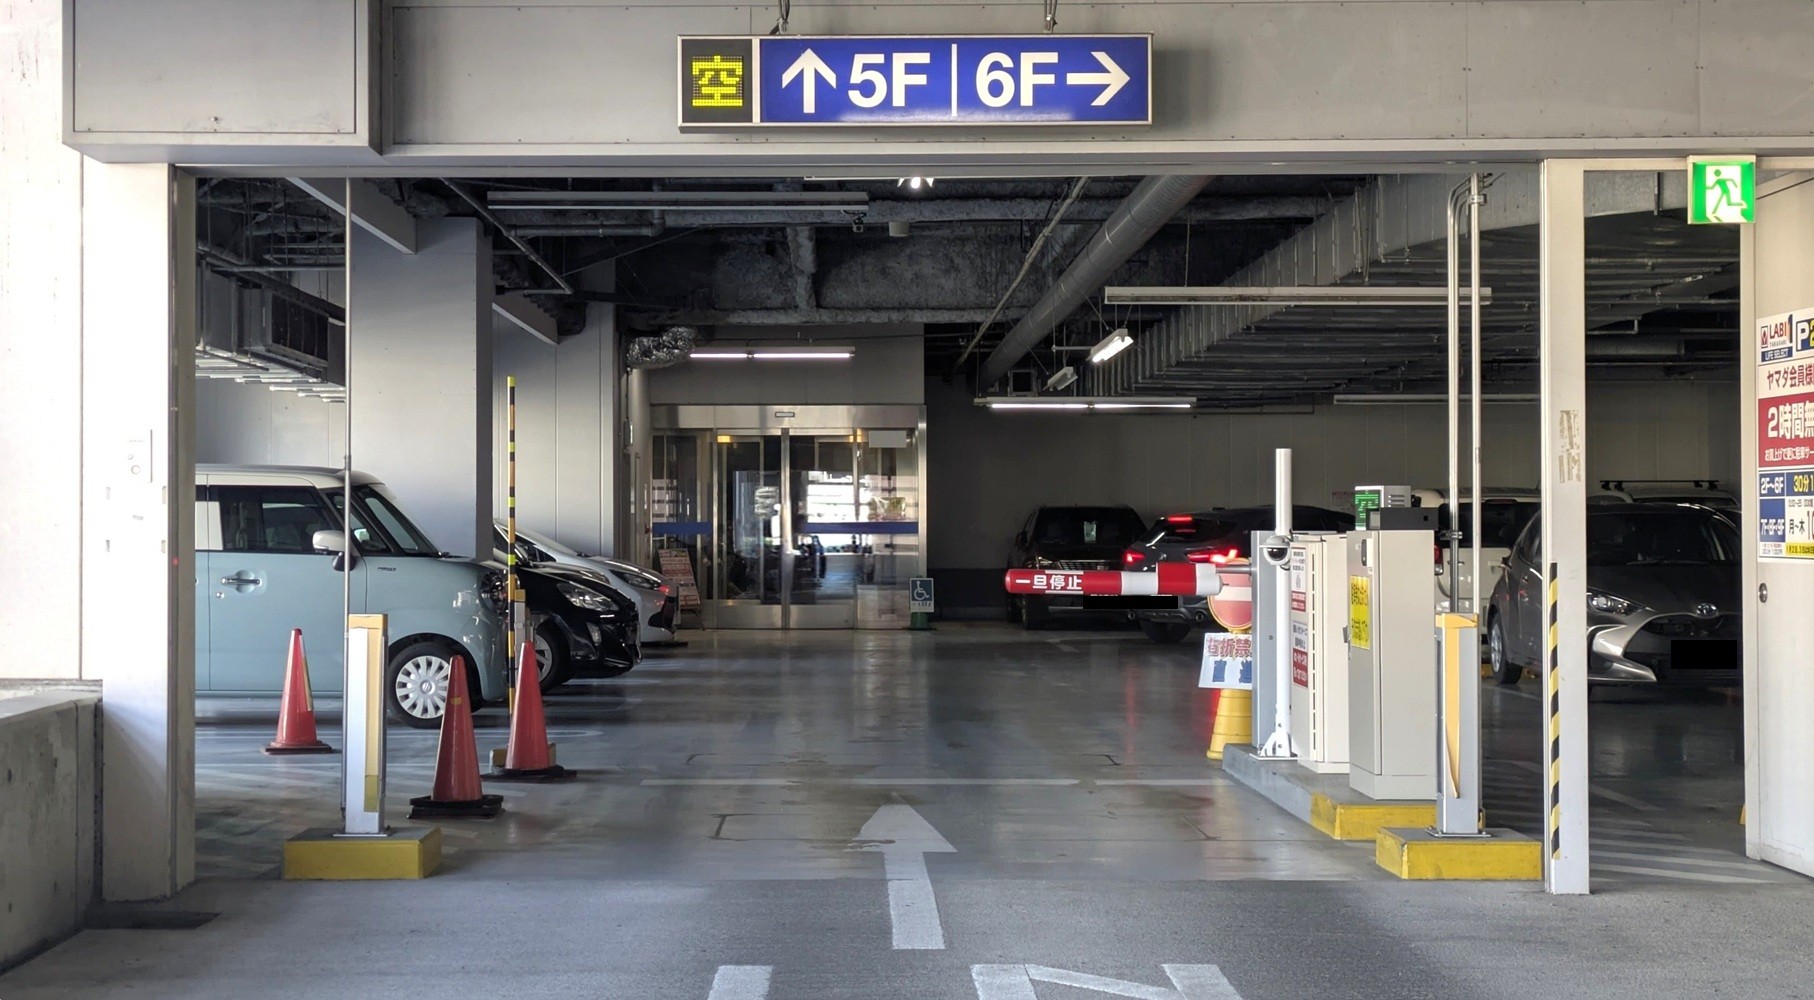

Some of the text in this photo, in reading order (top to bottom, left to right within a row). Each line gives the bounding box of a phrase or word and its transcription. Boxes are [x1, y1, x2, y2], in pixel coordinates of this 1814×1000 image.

[692, 55, 743, 107] 空
[847, 51, 1060, 108] 5F 6F
[1015, 574, 1083, 591] 一旦停止
[1206, 636, 1252, 658] 右折禁
